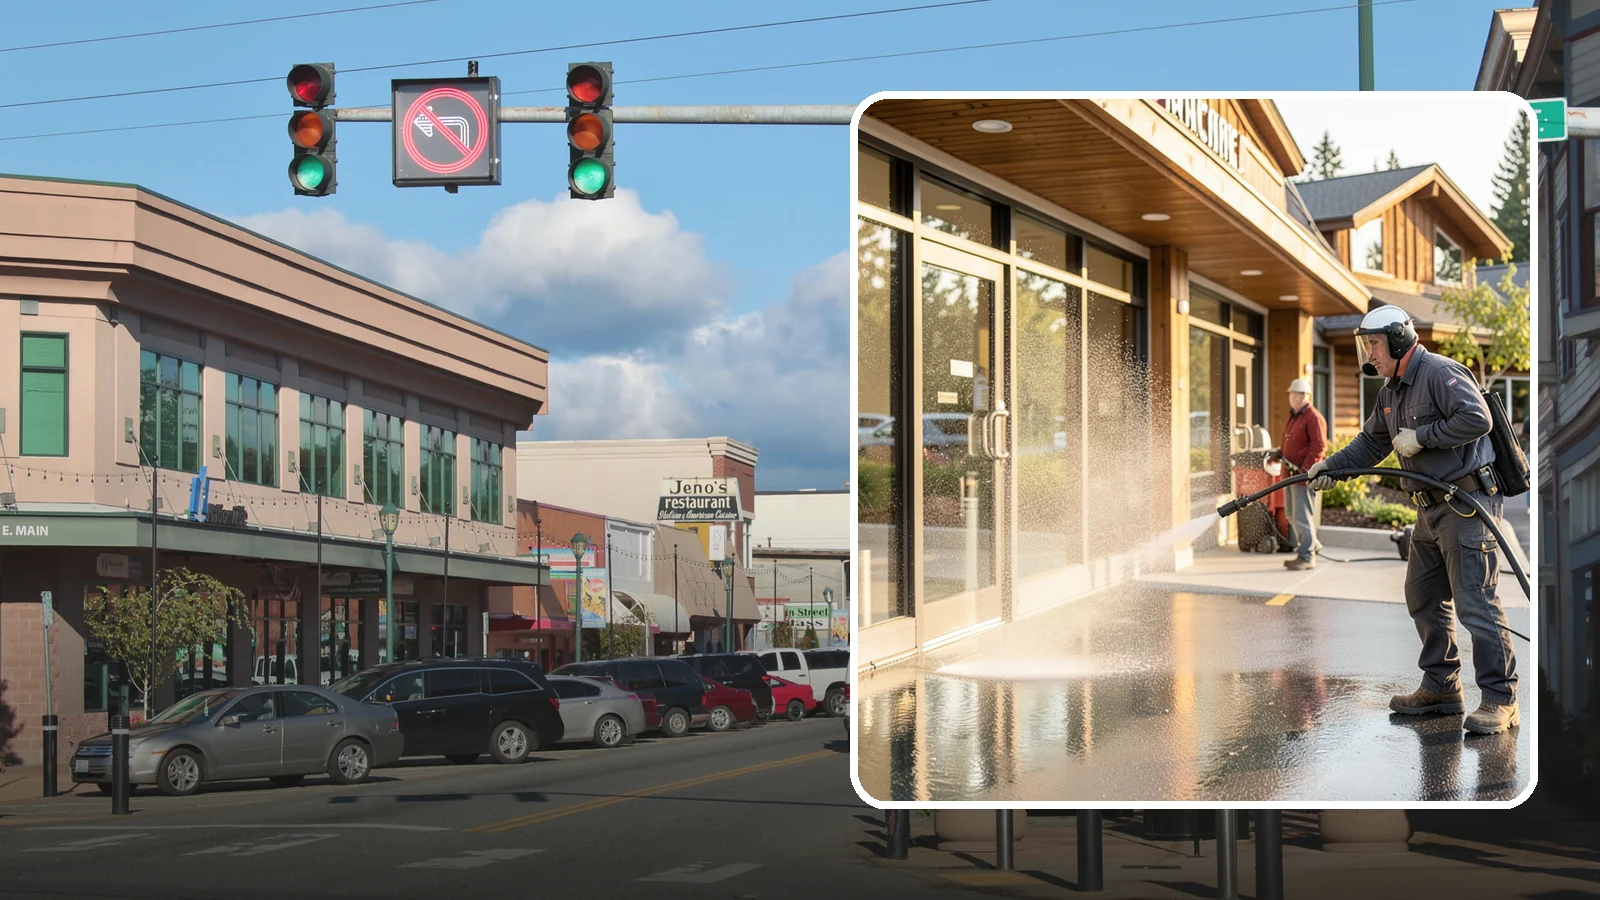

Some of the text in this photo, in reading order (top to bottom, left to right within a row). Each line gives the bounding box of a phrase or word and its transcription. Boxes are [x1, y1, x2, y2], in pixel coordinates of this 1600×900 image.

[670, 480, 727, 494] Jeno's
[665, 496, 731, 509] restaurant
[659, 510, 681, 519] Italian
[686, 510, 714, 519] American
[715, 510, 737, 519] Cuisine
[2, 525, 49, 536] E. MAIN
[797, 607, 828, 617] Street
